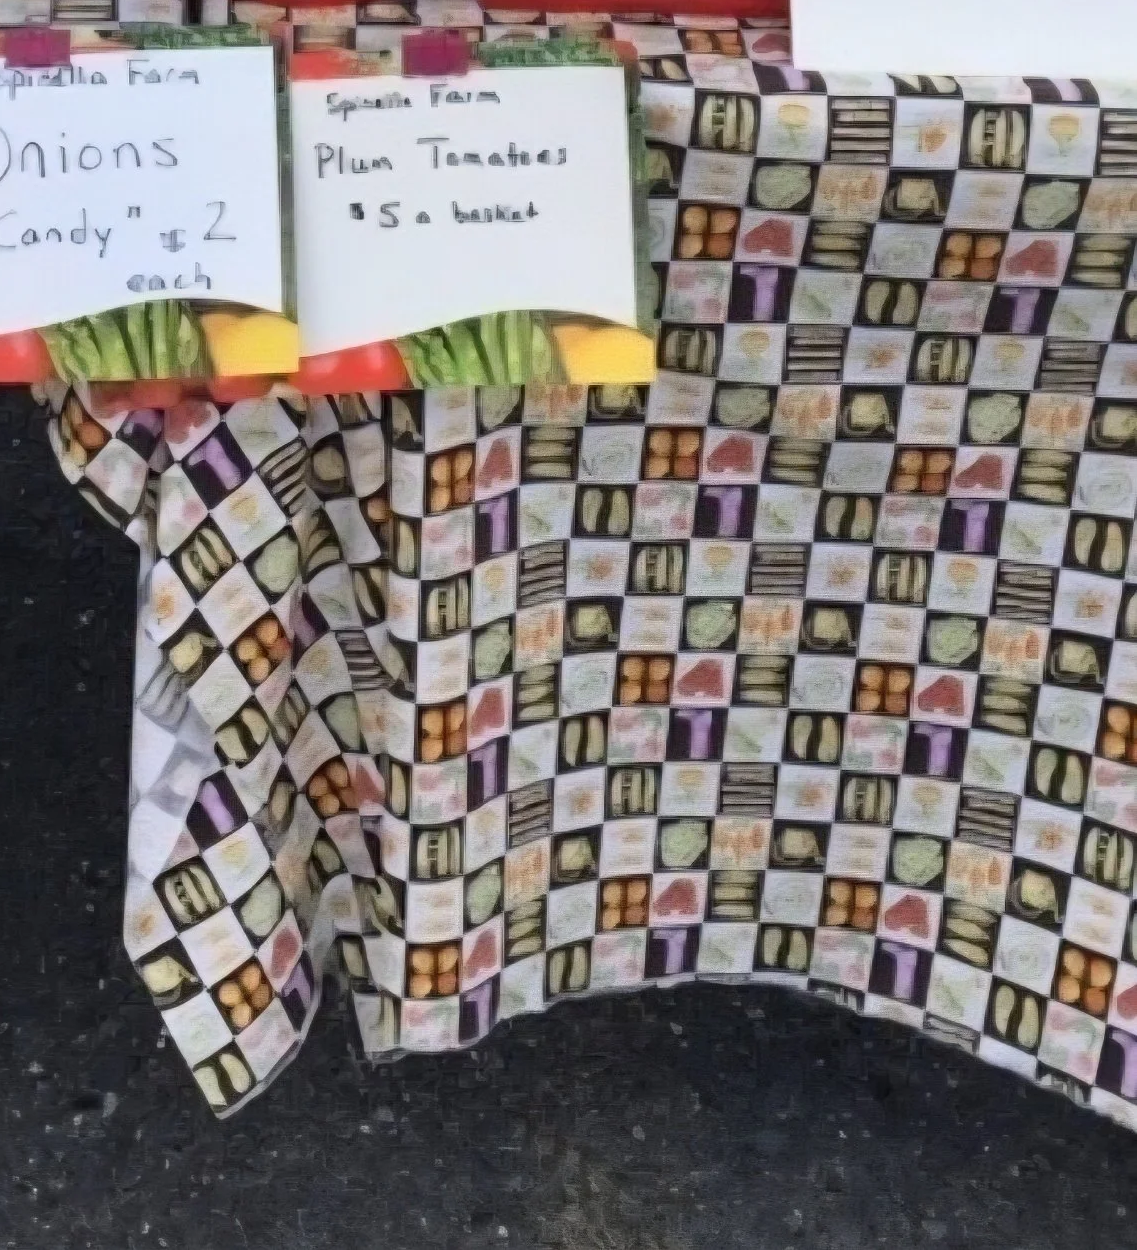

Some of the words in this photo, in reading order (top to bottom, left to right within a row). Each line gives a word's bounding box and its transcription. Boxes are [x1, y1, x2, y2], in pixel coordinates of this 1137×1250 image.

[126, 58, 200, 85] Farm
[428, 82, 501, 108] Farm
[314, 142, 393, 179] Plum
[415, 136, 568, 170] Tomatoes
[451, 199, 540, 224] basket
[126, 261, 213, 292] each
